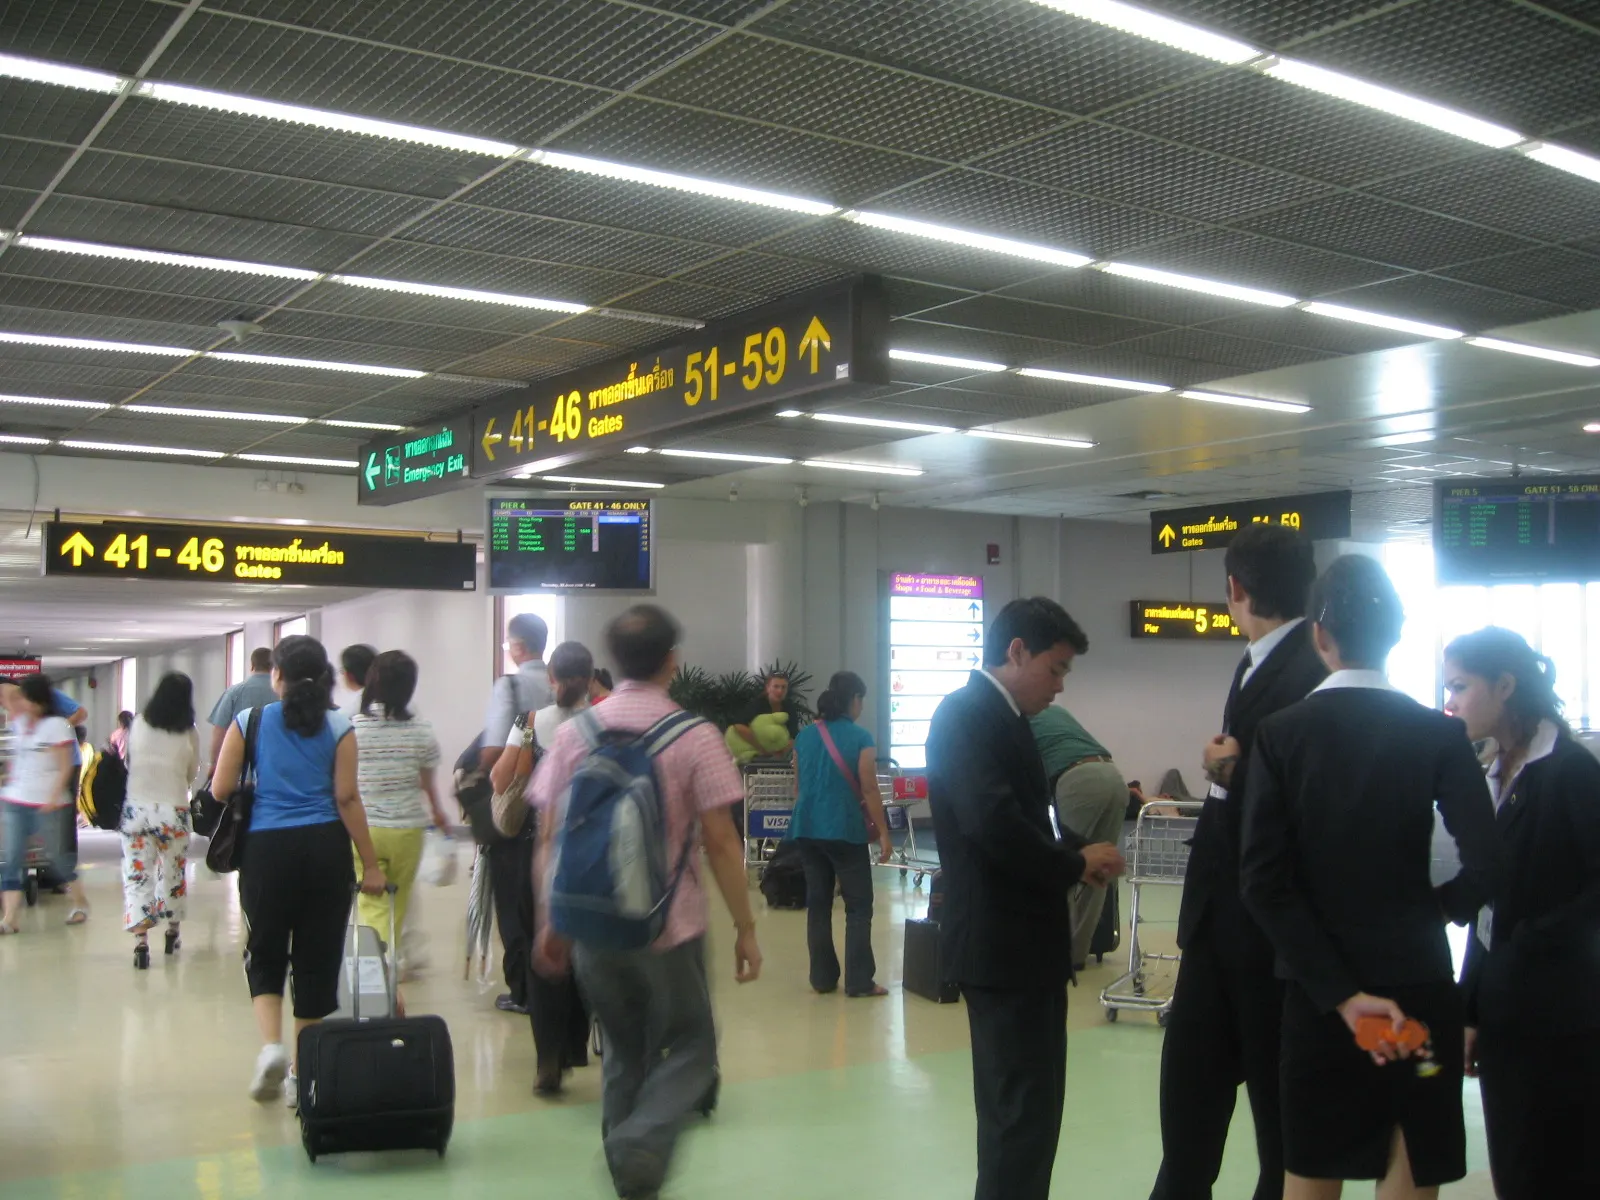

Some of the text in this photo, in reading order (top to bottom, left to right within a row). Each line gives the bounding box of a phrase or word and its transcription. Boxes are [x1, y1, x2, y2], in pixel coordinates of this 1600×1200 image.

[684, 326, 787, 407] 51-59
[508, 390, 581, 454] 41-46
[588, 414, 623, 438] Gates
[403, 453, 463, 484] Emergency Exit
[569, 502, 592, 510] GATE
[593, 502, 604, 510] 41
[611, 502, 622, 510] 46
[623, 502, 647, 510] ONLY
[1182, 538, 1203, 547] Gates
[234, 562, 282, 579] Gates
[1144, 623, 1160, 633] Pier
[1195, 608, 1208, 633] 5
[1212, 614, 1230, 628] 280
[767, 818, 790, 826] VISA
